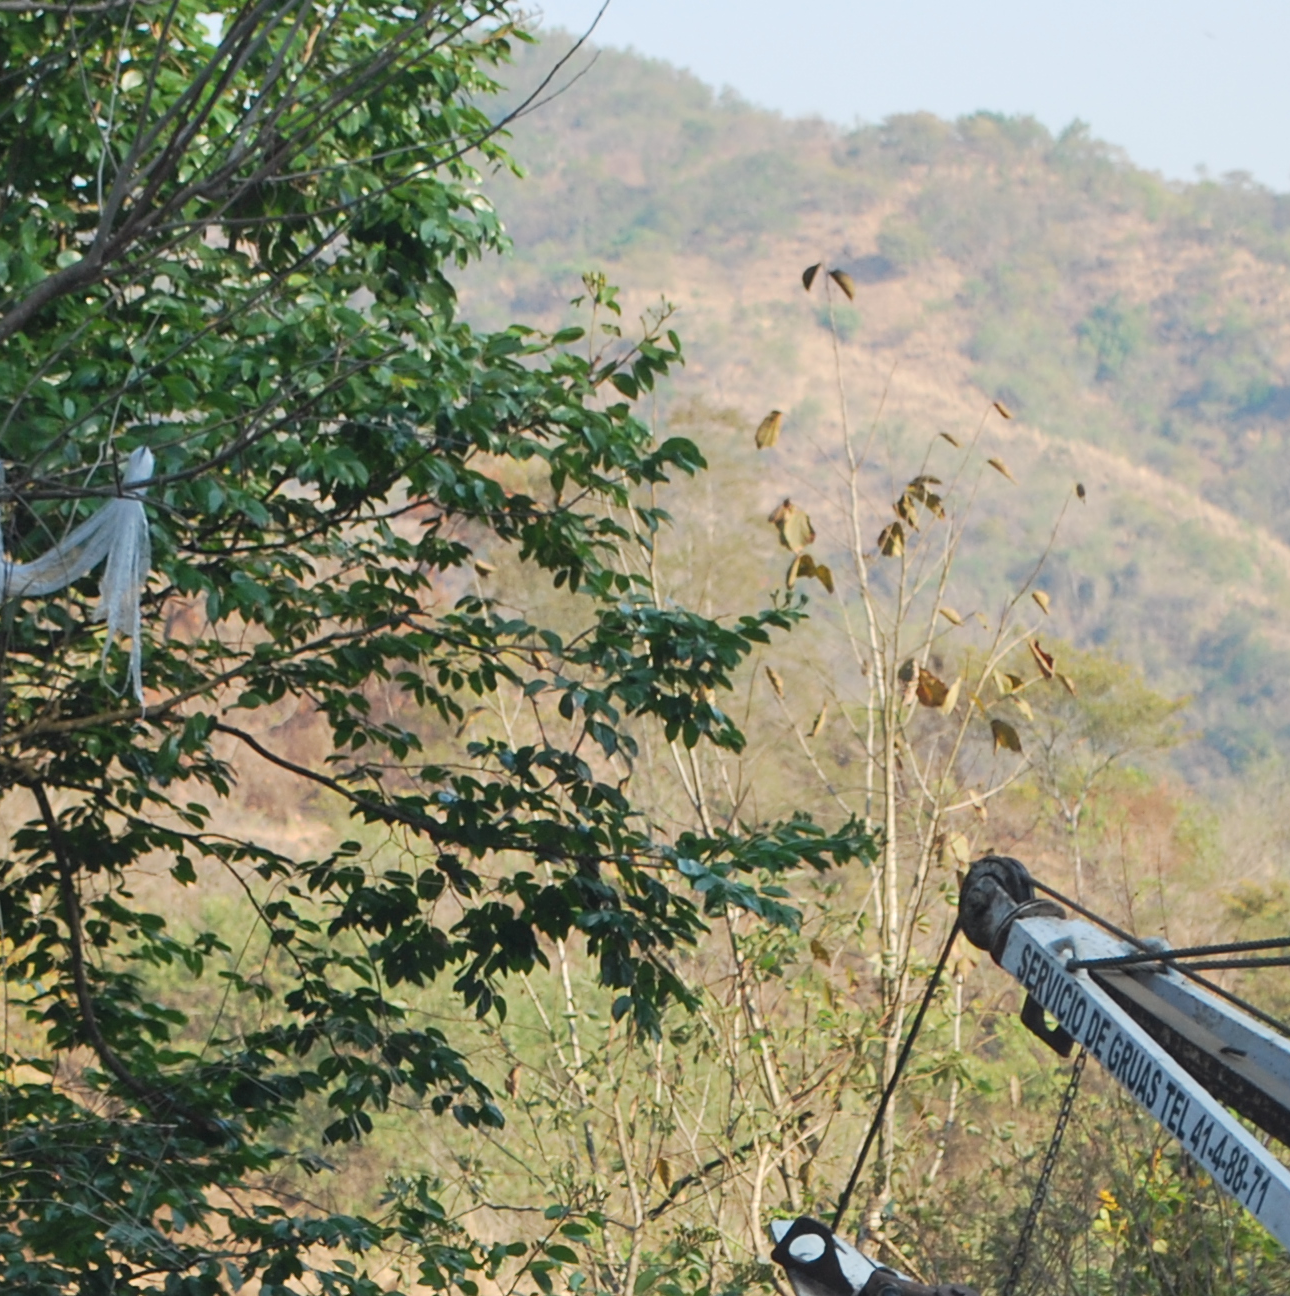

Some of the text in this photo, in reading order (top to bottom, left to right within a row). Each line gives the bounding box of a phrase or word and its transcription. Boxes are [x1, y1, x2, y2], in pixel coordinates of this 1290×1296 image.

[1016, 943, 1272, 1215] SERVICIO DE GRUAS TEL 41-4-88-71
